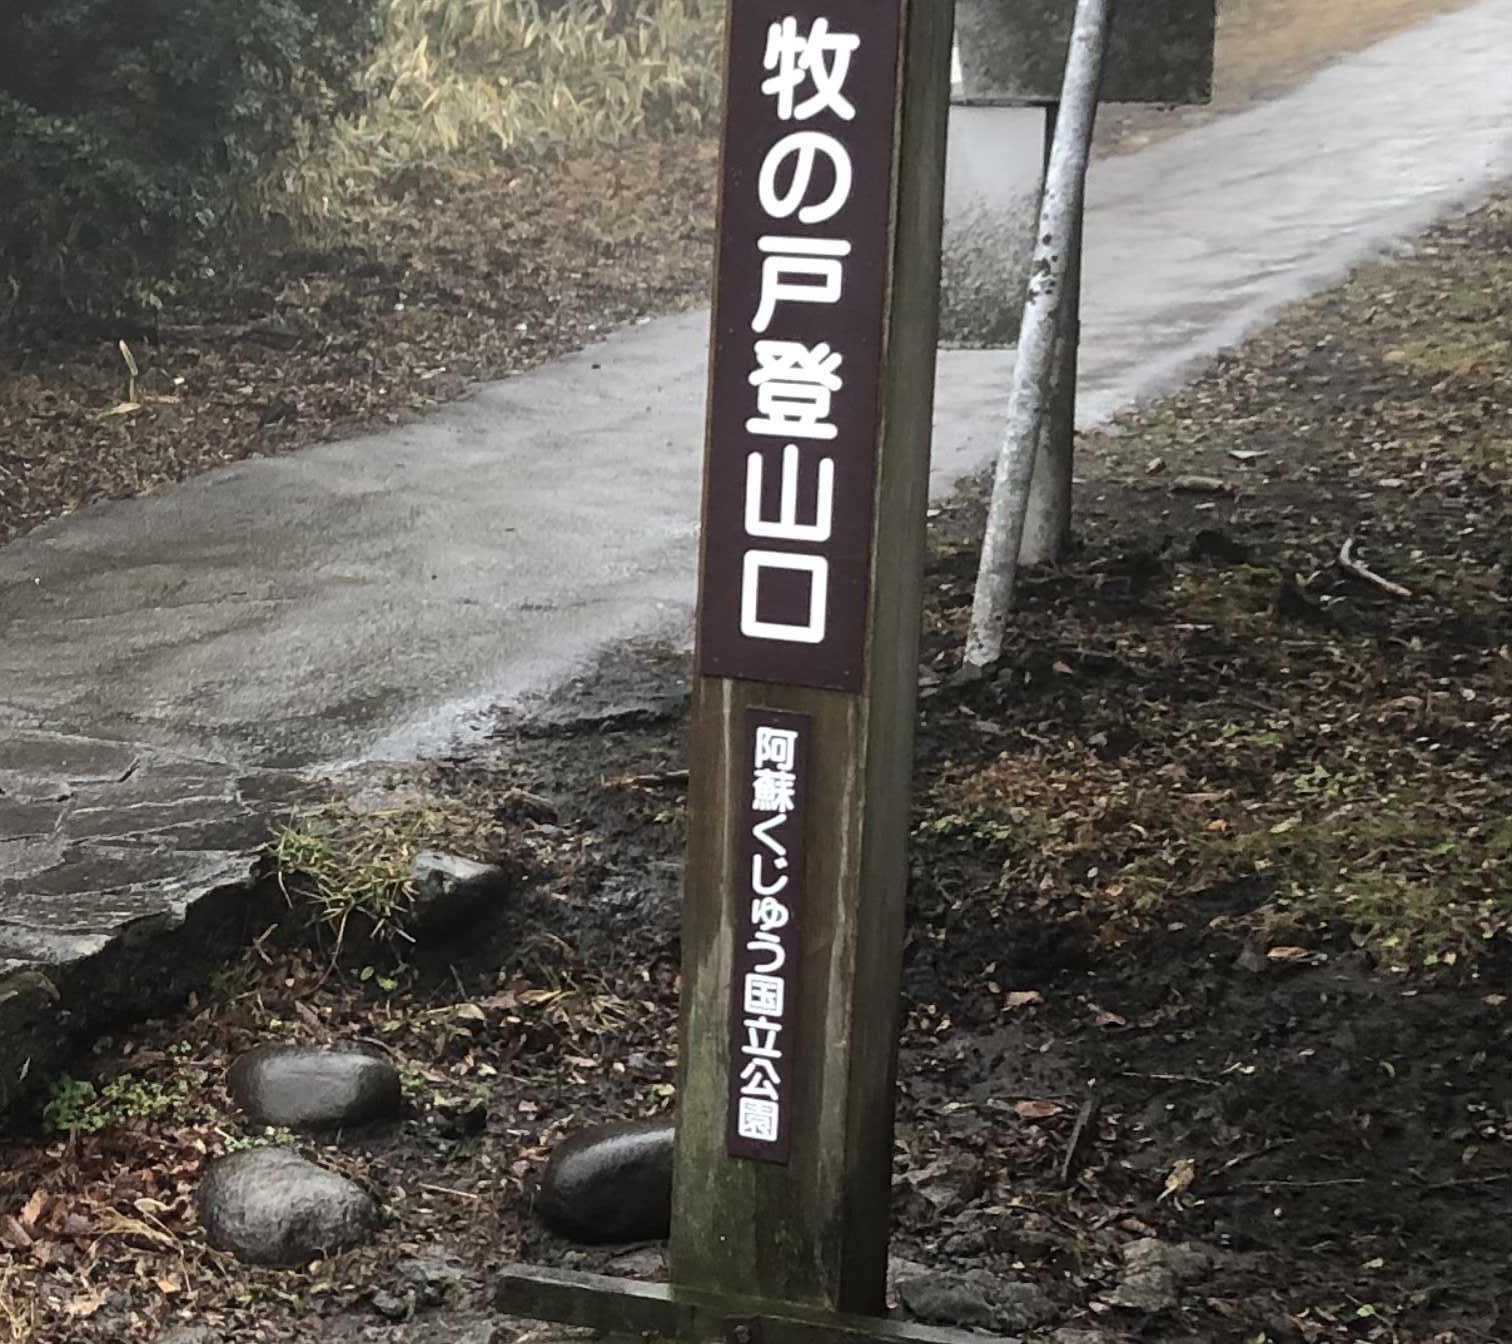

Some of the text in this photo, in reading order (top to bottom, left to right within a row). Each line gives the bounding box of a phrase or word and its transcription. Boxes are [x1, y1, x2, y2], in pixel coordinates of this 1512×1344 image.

[739, 14, 861, 645] 牧の戸登山口
[737, 725, 799, 1143] 阿蘇くじゅう国立公園
